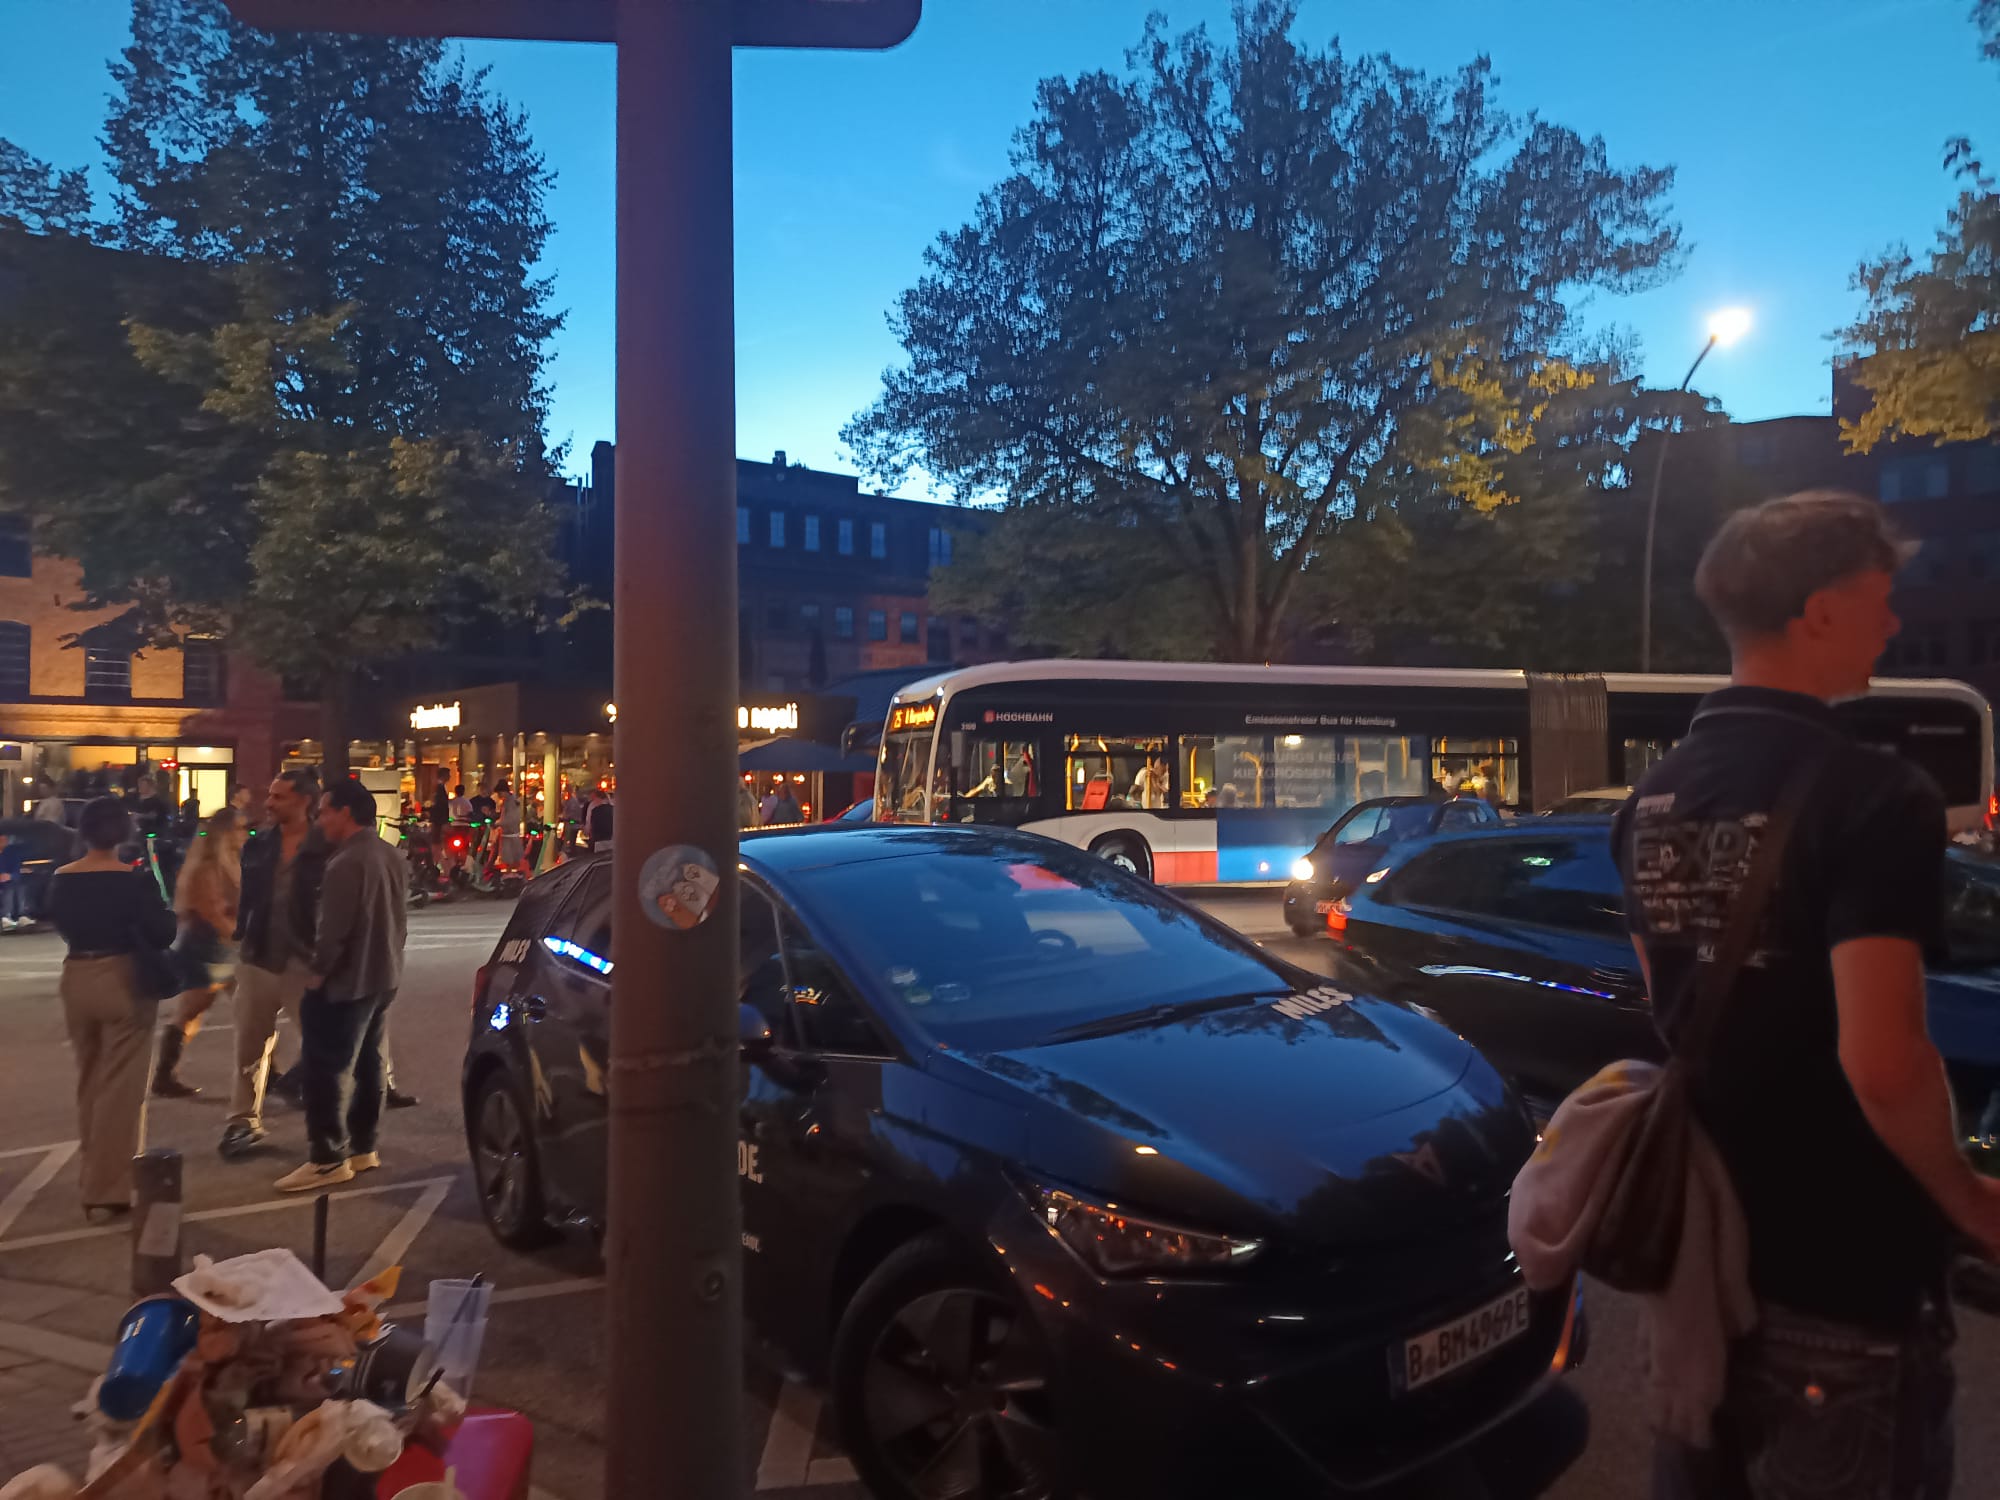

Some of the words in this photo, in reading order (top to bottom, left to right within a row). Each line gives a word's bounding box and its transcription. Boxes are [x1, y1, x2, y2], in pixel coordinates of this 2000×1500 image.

[996, 712, 1054, 722] HOCHBAHN
[1320, 714, 1338, 725] Bus
[1340, 714, 1353, 725] für
[1355, 715, 1396, 727] Hamburg
[1408, 1344, 1423, 1382] B
